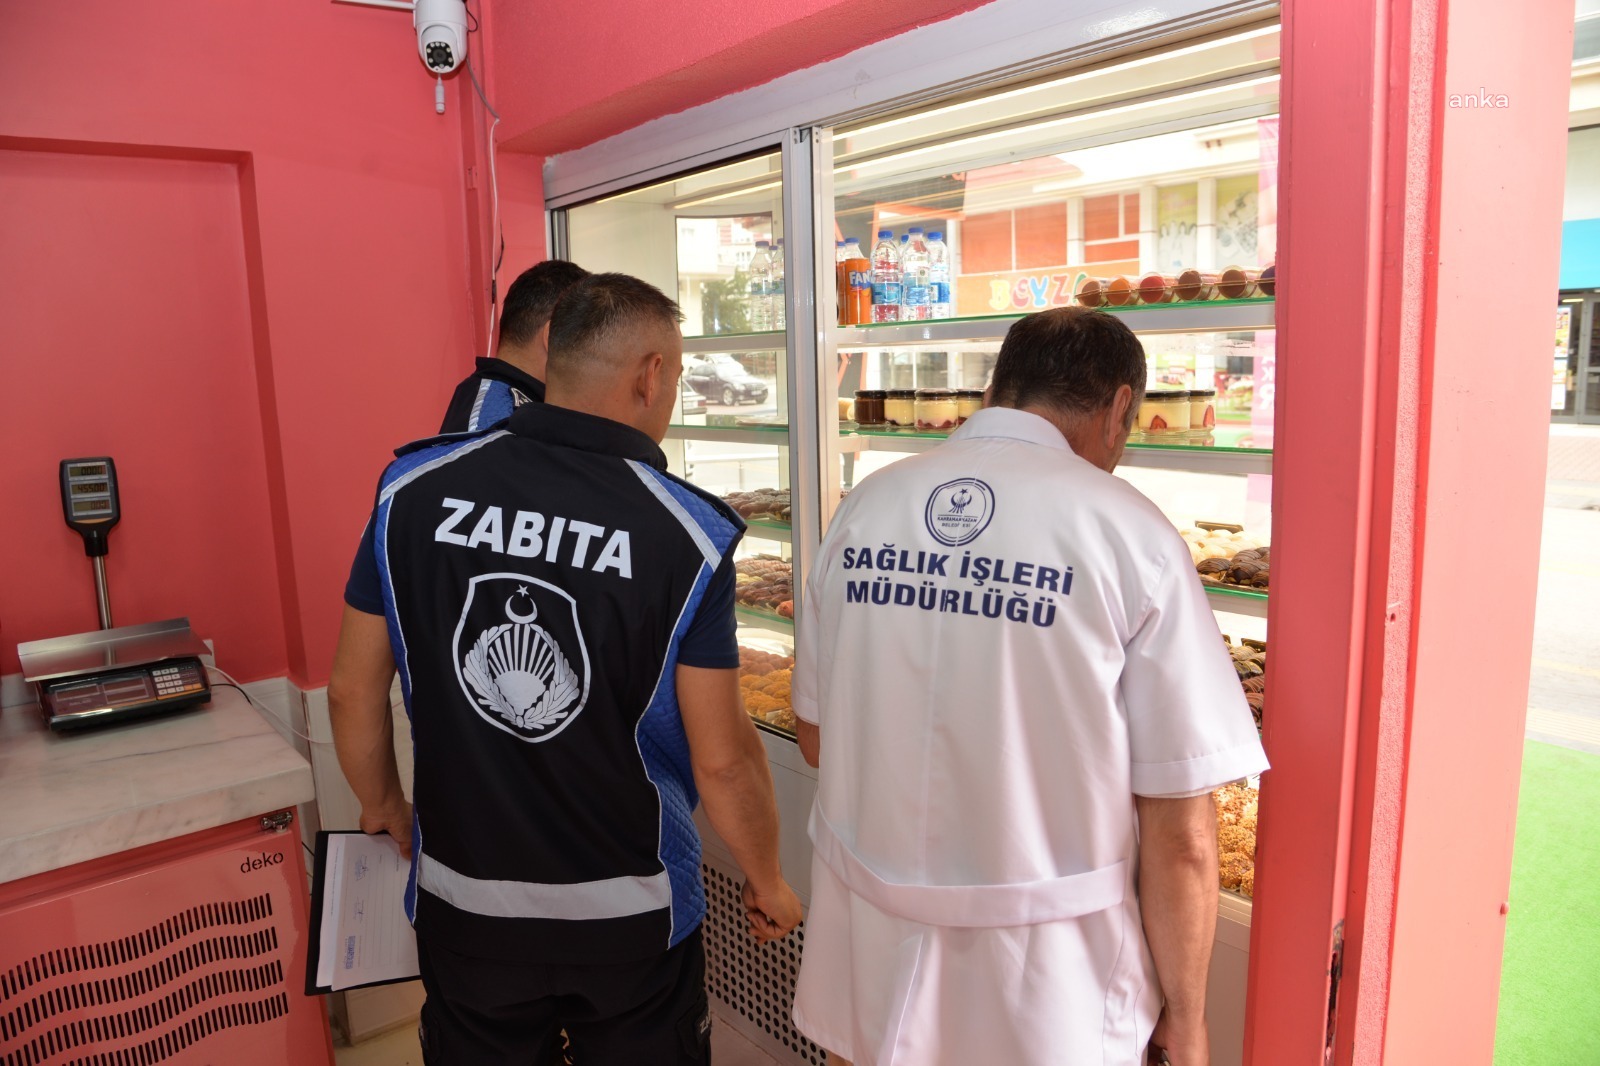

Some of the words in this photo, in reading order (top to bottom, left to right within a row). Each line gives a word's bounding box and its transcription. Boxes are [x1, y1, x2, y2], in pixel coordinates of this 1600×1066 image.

[434, 497, 633, 580] ZABITA
[843, 543, 951, 577] SAĞLIK
[959, 550, 1074, 596] İŞLERİ
[846, 577, 1057, 628] MÜDÜRLÜĞÜ
[240, 852, 284, 874] deko
